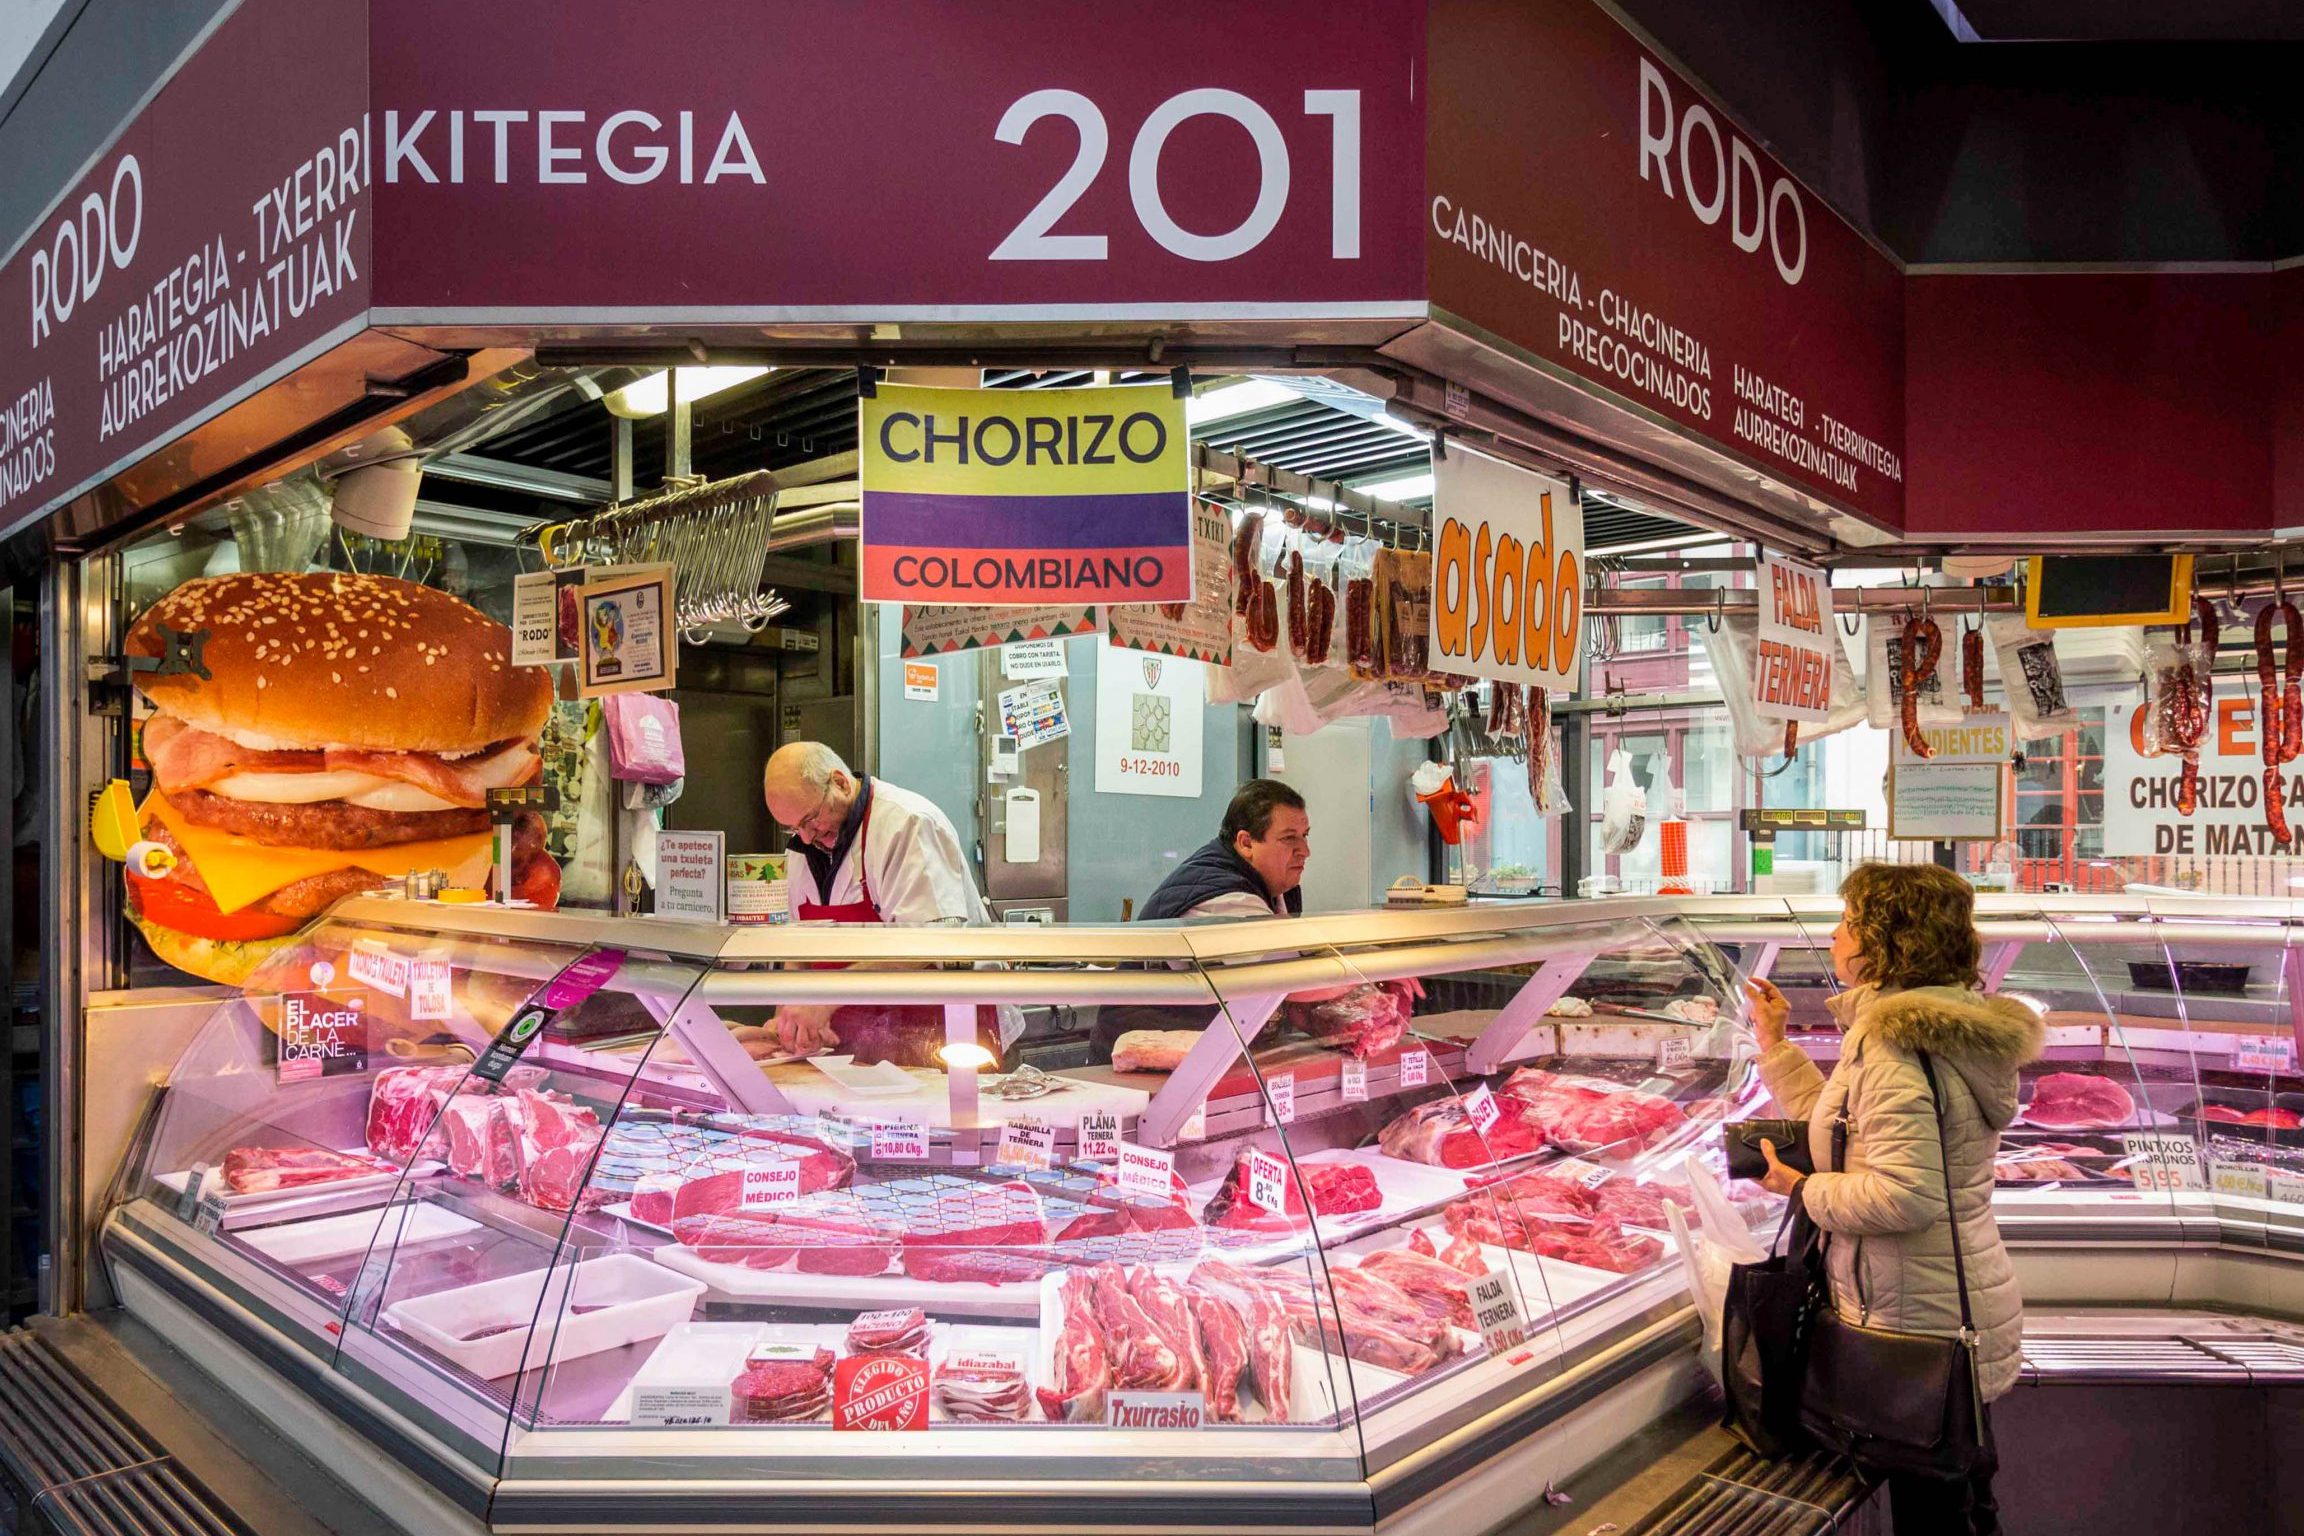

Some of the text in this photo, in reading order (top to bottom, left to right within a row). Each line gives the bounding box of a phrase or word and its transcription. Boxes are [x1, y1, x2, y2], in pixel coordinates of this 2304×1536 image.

[385, 110, 767, 185] KITEGIA
[988, 88, 1361, 262] 201
[1640, 56, 1806, 285] RODO
[32, 154, 143, 349] RODO
[100, 233, 230, 382] HARATEGIA
[252, 112, 370, 264] TXERRI
[1432, 195, 1583, 311] CARNICERIA
[1600, 288, 1712, 381] CHACINERIA
[100, 208, 358, 443] AURREKOZINATUAK
[1559, 312, 1712, 421] PRECOCINADOS
[1733, 363, 1804, 430] HARATEGI
[1821, 413, 1902, 483] TXERRIKITEGIA
[880, 411, 1168, 466] CHORIZO
[1733, 406, 1858, 493] AURREKOZINATUAK
[893, 556, 1164, 589] COLOMBIANO
[1436, 492, 1580, 677] asado
[1771, 563, 1823, 635] FALDA
[1757, 639, 1831, 711] TERNERA
[1120, 757, 1180, 777] 9-12-2010
[661, 839, 714, 853] ¿Te apetece
[2155, 824, 2195, 855] DE
[661, 853, 714, 866] una txuleta
[670, 867, 706, 880] perfecta?
[669, 886, 704, 900] Pregunta
[676, 902, 715, 914] carnicero.
[286, 999, 310, 1015] EL
[286, 1011, 359, 1030] PLACER
[286, 1027, 340, 1046] DE LA
[1008, 1135, 1044, 1148] TERNERA
[1020, 1130, 1031, 1138] DE
[1087, 1131, 1114, 1140] TERNERA
[2127, 1140, 2193, 1153] PINTXOS
[1123, 1152, 1169, 1172] CONSEJO
[1253, 1156, 1283, 1186] OFERTA
[2132, 1153, 2196, 1166] ORUNOS
[746, 1170, 797, 1183] CONSEJO
[1122, 1171, 1167, 1190] MÉDICO
[745, 1190, 795, 1204] MÉDICO
[1476, 1279, 1504, 1304] FALDA
[1477, 1300, 1517, 1329] TERNERA
[957, 1357, 1017, 1370] idiazabal
[853, 1362, 904, 1394] ELEGIDO
[843, 1375, 925, 1423] PRODUCTO
[868, 1417, 892, 1430] DEL
[1112, 1399, 1200, 1428] Txurrasko
